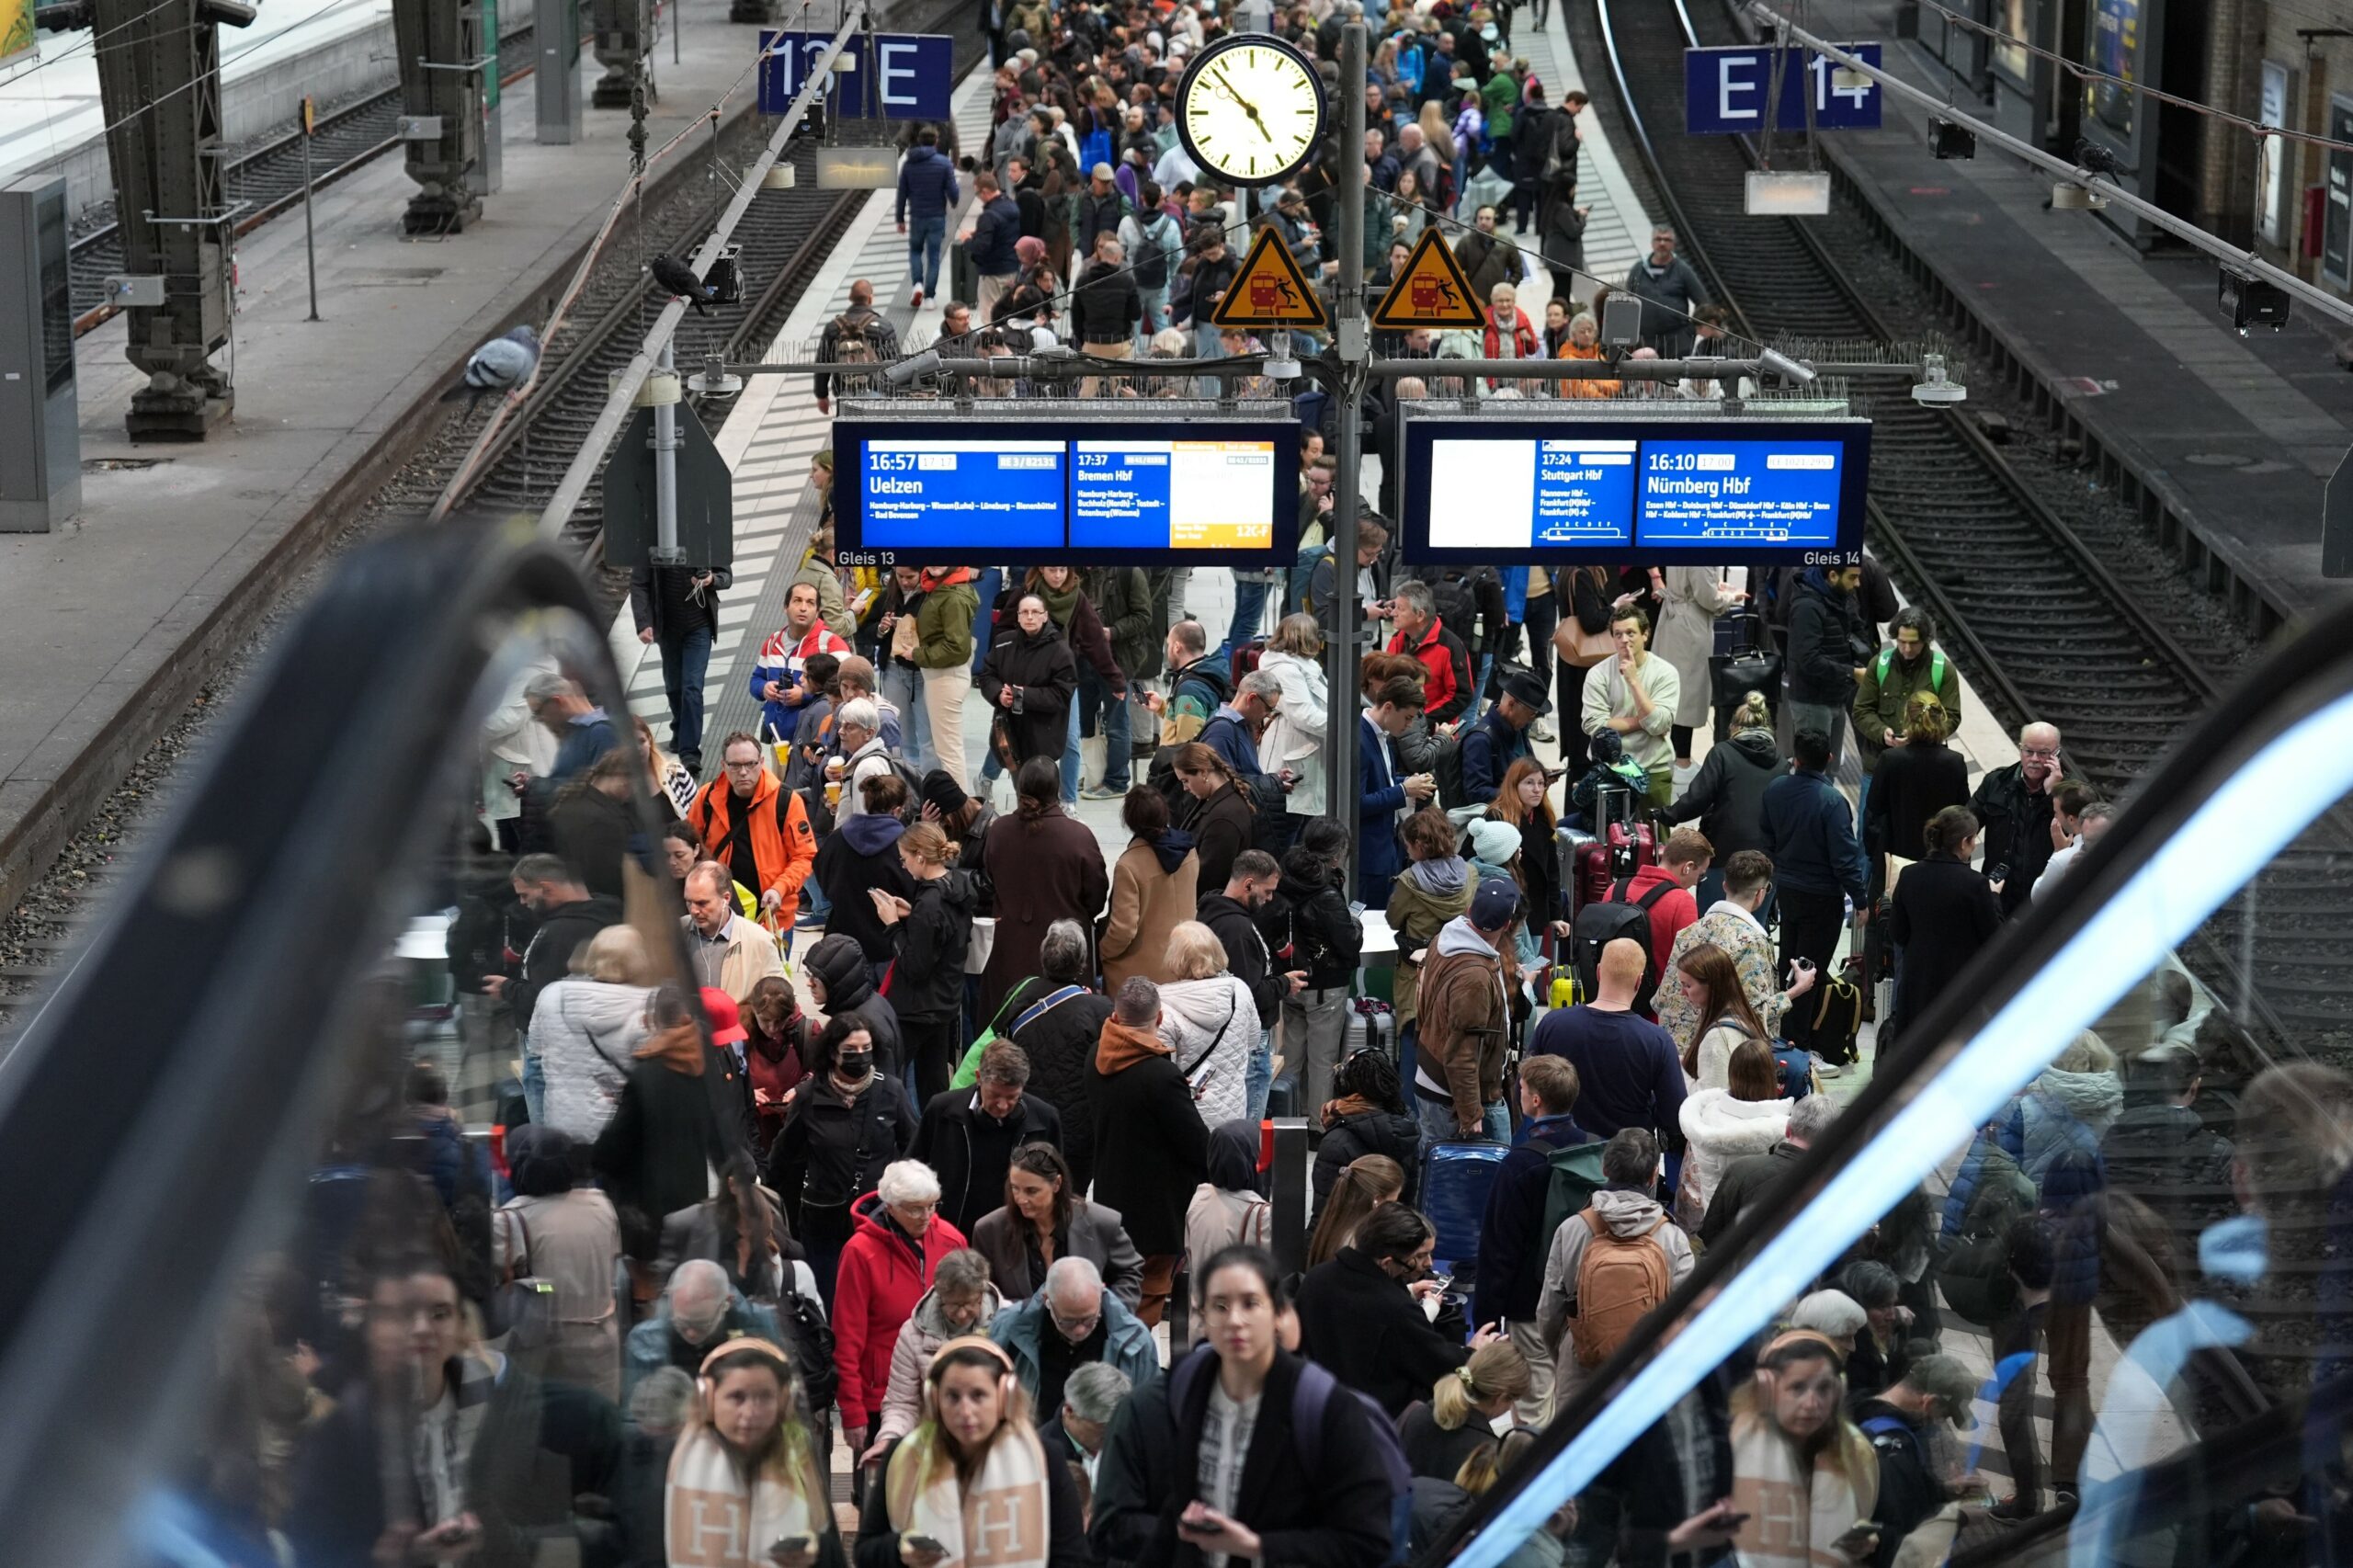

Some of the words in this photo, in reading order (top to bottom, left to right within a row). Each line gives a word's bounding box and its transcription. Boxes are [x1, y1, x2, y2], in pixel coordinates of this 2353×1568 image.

[764, 40, 835, 97] 13
[880, 43, 918, 105] E
[1720, 57, 1757, 119] E
[1812, 52, 1870, 110] 14
[870, 454, 915, 470] 16:57
[1079, 455, 1108, 465] 17:37
[1543, 454, 1572, 464] 17:24
[1650, 454, 1695, 471] 16:10
[1078, 471, 1113, 481] Bremen
[1116, 471, 1132, 481] Hbf
[1541, 470, 1583, 483] Stuttgart
[1586, 470, 1602, 480] Hbf
[870, 477, 922, 494] Uelzen
[1648, 477, 1719, 497] Nürnberg
[1723, 477, 1751, 494] Hbf
[1078, 490, 1133, 499] Hamburg-Harburg
[870, 502, 926, 511] Hamburg-Harburg
[981, 503, 1011, 511] Lüneburg
[1078, 499, 1131, 507] Buchholz(Nordh)
[1683, 502, 1711, 510] Duisburg
[1078, 509, 1140, 517] Rotenburg(Wümme)
[839, 551, 876, 564] Gleis
[881, 551, 894, 565] 13
[1804, 551, 1840, 565] Gleis
[1846, 551, 1860, 564] 14
[975, 1496, 1021, 1556] H
